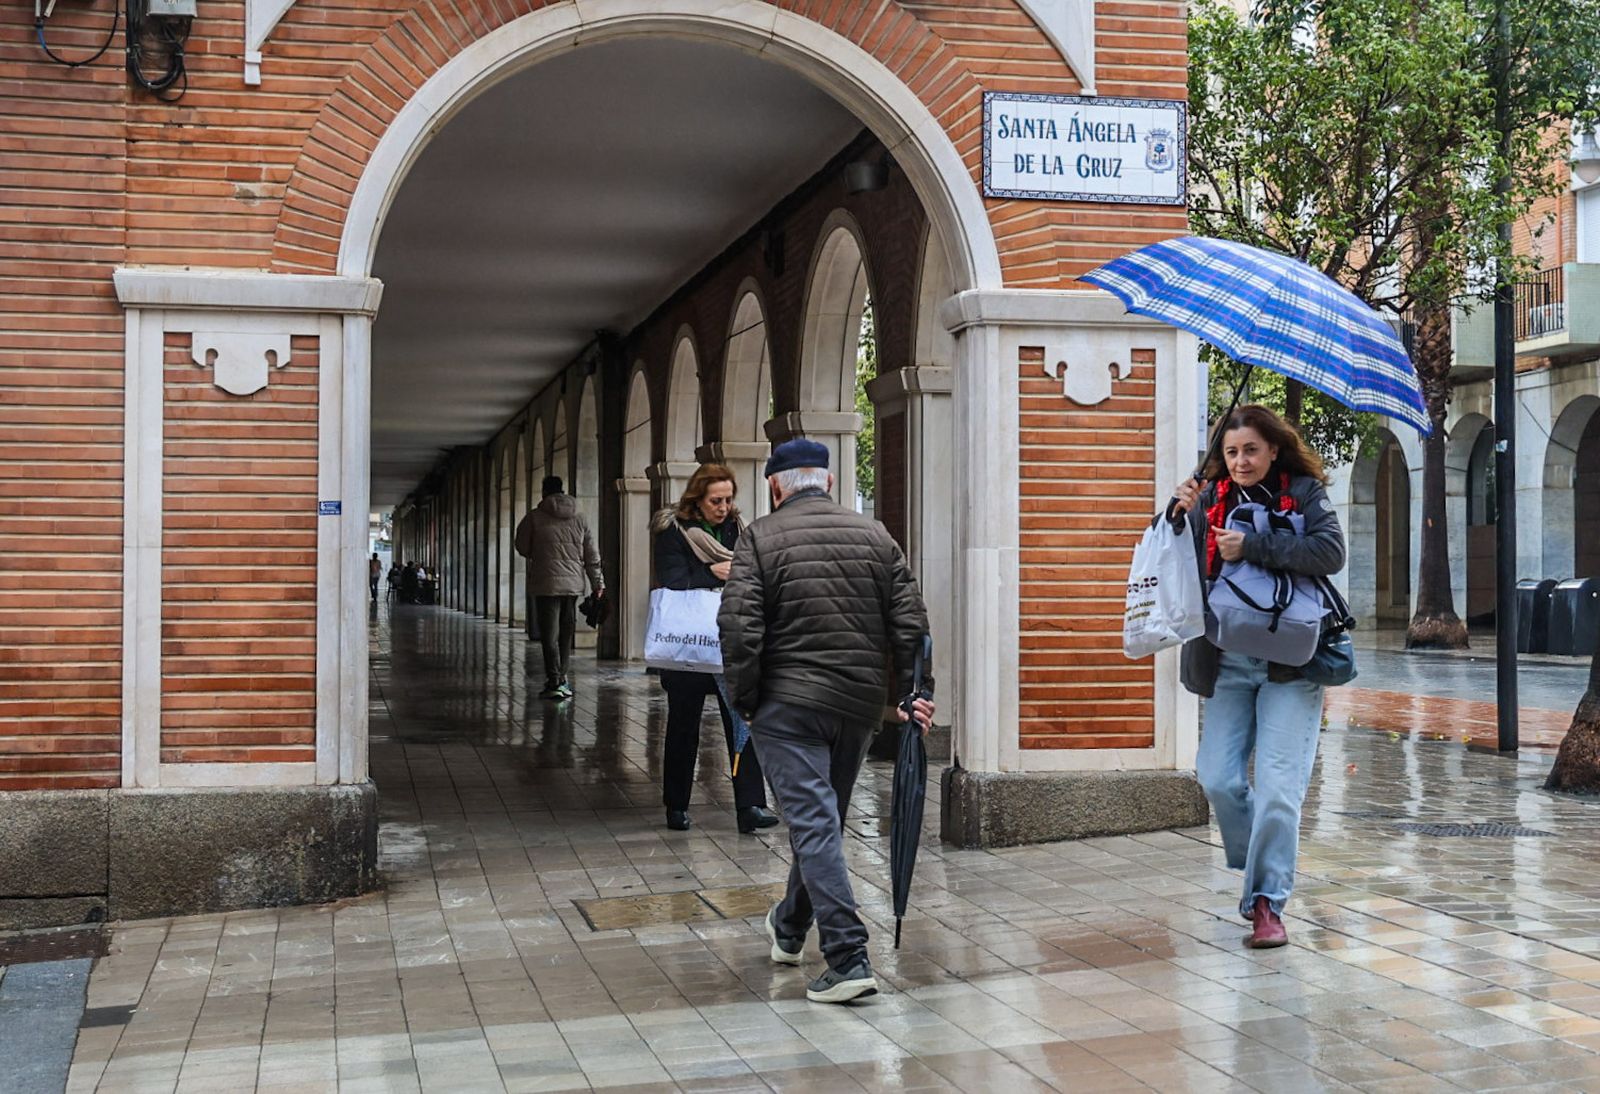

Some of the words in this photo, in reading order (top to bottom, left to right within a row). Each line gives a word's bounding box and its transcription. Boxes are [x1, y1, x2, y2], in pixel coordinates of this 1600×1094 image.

[998, 114, 1058, 140] SANTA
[1068, 112, 1136, 143] ÁNGELA
[1014, 154, 1035, 174] DE
[1042, 155, 1064, 175] LA
[1076, 154, 1122, 178] CRUZ
[655, 633, 681, 643] Pedro
[682, 634, 697, 645] del
